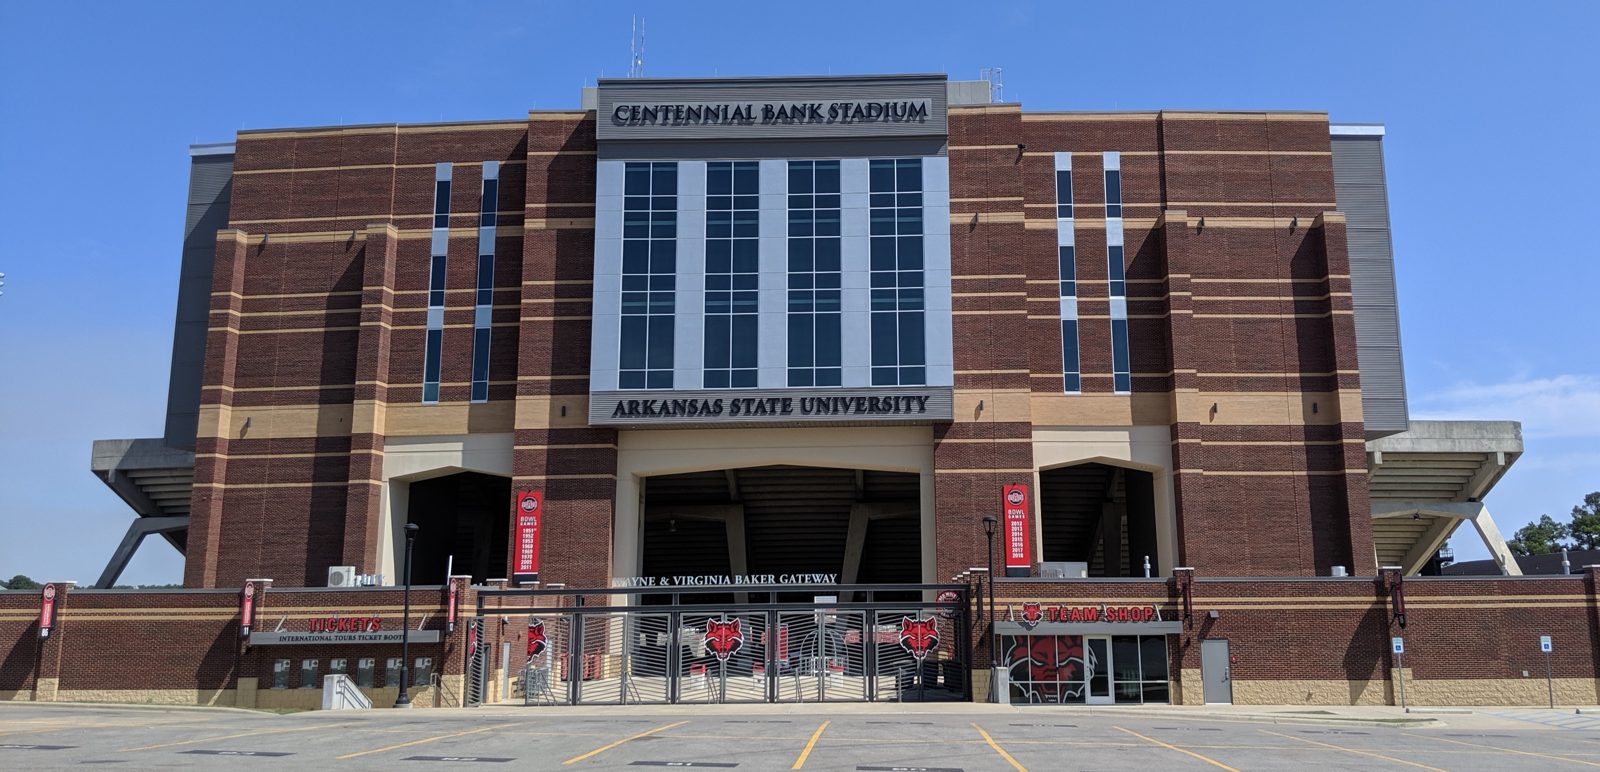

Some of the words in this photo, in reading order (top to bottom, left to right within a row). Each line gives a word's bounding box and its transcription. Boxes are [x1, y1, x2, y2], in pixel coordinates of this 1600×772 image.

[614, 104, 757, 122] CENTENNIAL
[764, 103, 825, 120] BANK
[829, 101, 929, 119] STADIUM
[612, 399, 724, 418] ARKANSAS
[729, 398, 793, 416] STATE
[800, 396, 930, 415] UNIVERSITY
[611, 576, 656, 587] WAYNE
[660, 576, 670, 586] &
[673, 575, 731, 586] VIRGINIA
[735, 574, 776, 585] BAKER
[779, 573, 838, 585] GATEWAY
[1050, 607, 1097, 622] TEAM
[1106, 606, 1154, 622] SHOP
[308, 617, 382, 633] TICKETS
